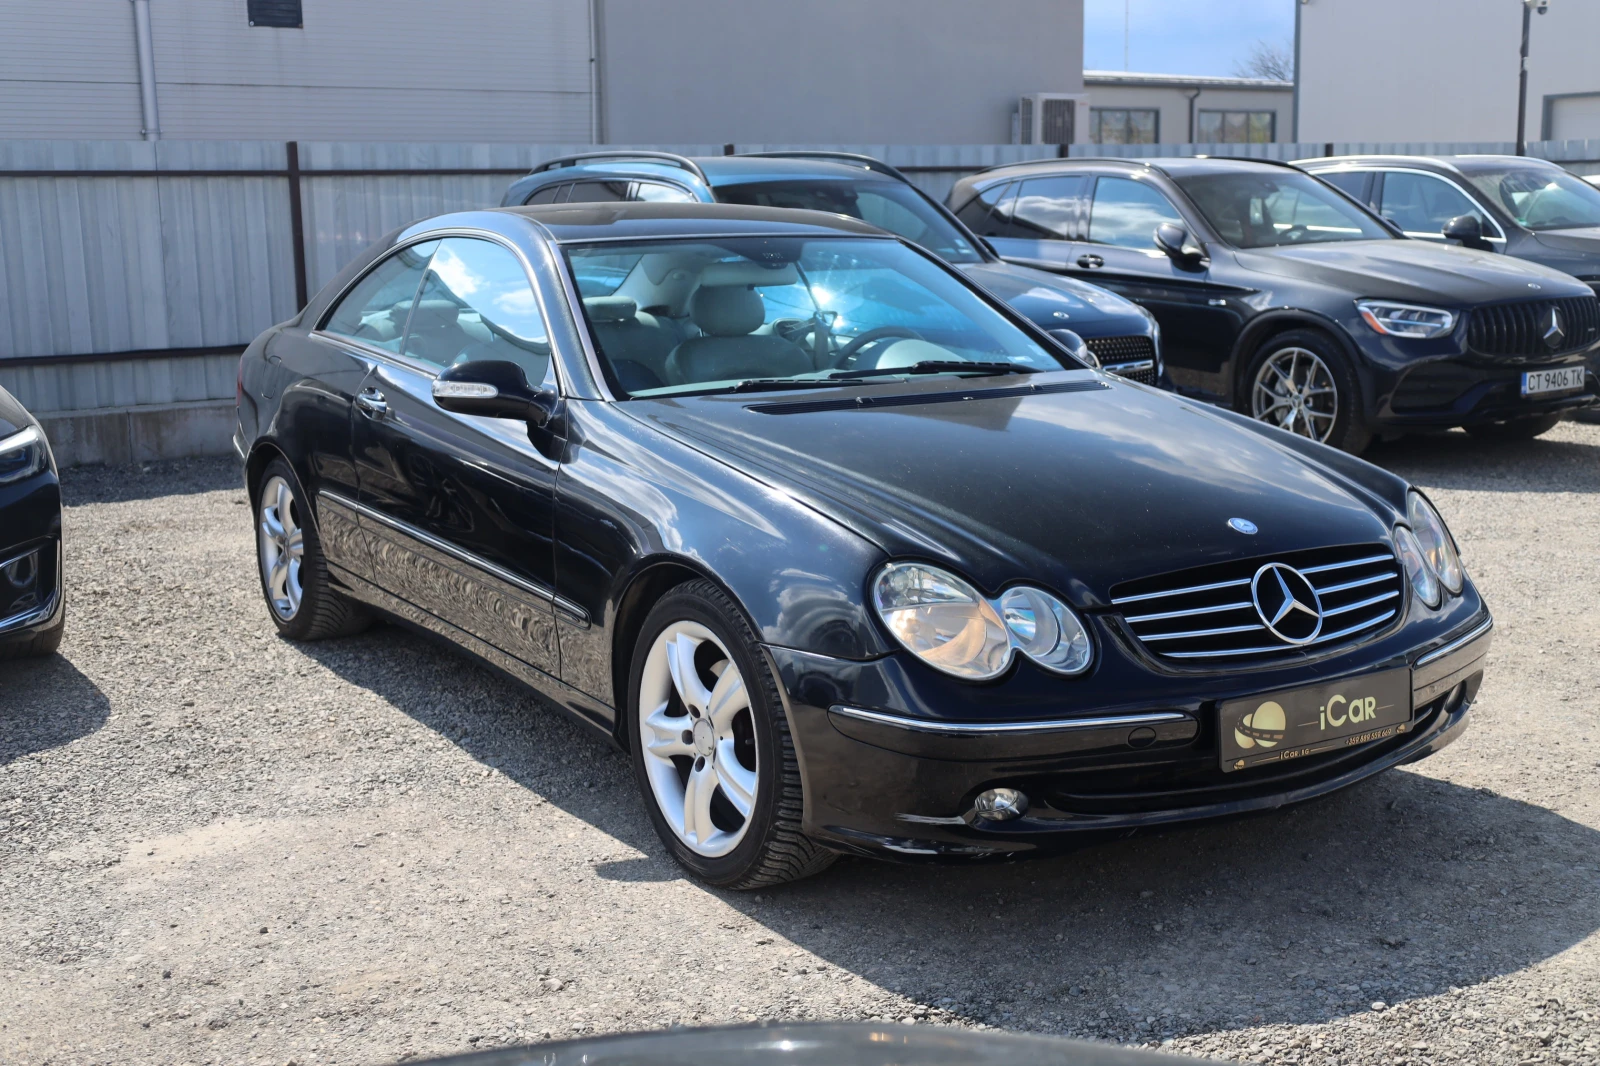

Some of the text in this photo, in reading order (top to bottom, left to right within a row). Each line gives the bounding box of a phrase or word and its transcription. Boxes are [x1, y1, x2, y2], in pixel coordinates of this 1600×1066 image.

[1529, 368, 1583, 390] CT 9406 TK
